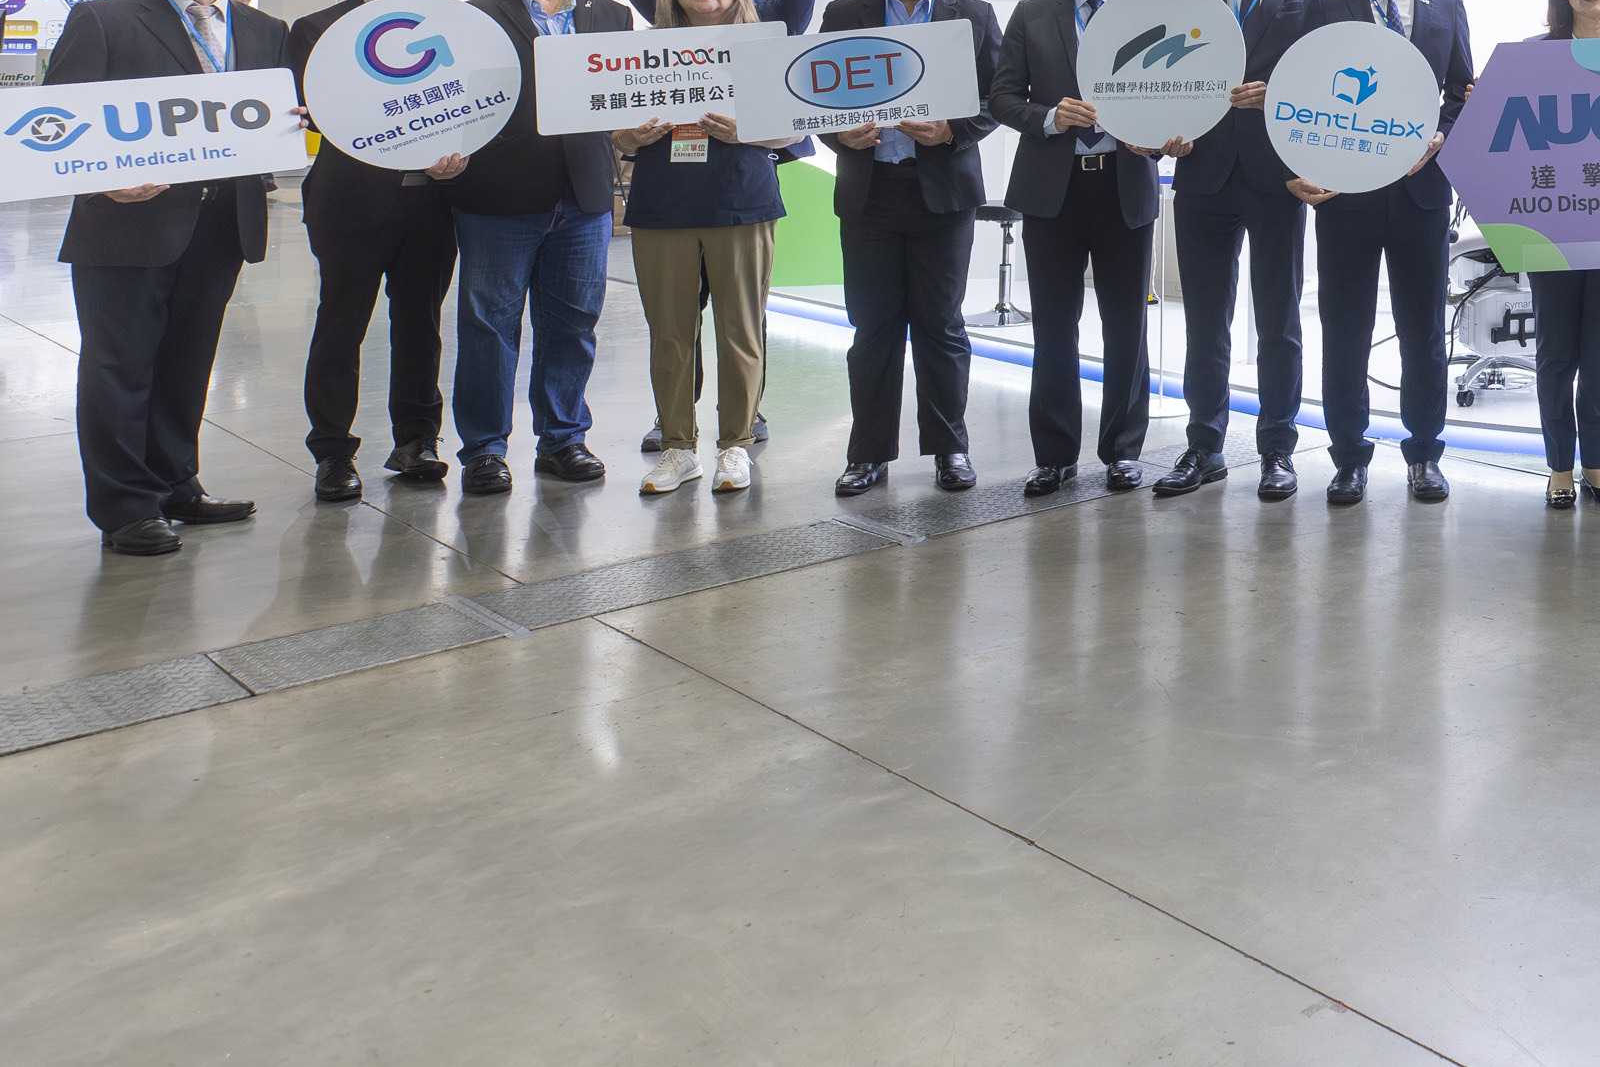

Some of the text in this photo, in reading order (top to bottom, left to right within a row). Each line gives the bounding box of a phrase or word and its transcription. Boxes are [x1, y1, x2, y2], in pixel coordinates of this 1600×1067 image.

[624, 70, 713, 85] Biotech Inc.
[810, 52, 902, 93] DET
[1092, 79, 1227, 94] 超微醫學科技股份有限公司
[382, 80, 465, 117] 易像國際
[1167, 93, 1200, 101] Technology
[103, 97, 271, 142] UPro
[352, 90, 511, 150] Great Choice Ltd.
[792, 103, 930, 131] 德益科技股份有限公司
[1275, 101, 1425, 140] DentLabX
[378, 111, 496, 155] The greatest choice you can ever done
[1288, 129, 1390, 156] 原色口腔數位
[54, 146, 237, 175] UPro Medical Inc.
[1508, 195, 1553, 215] AUO
